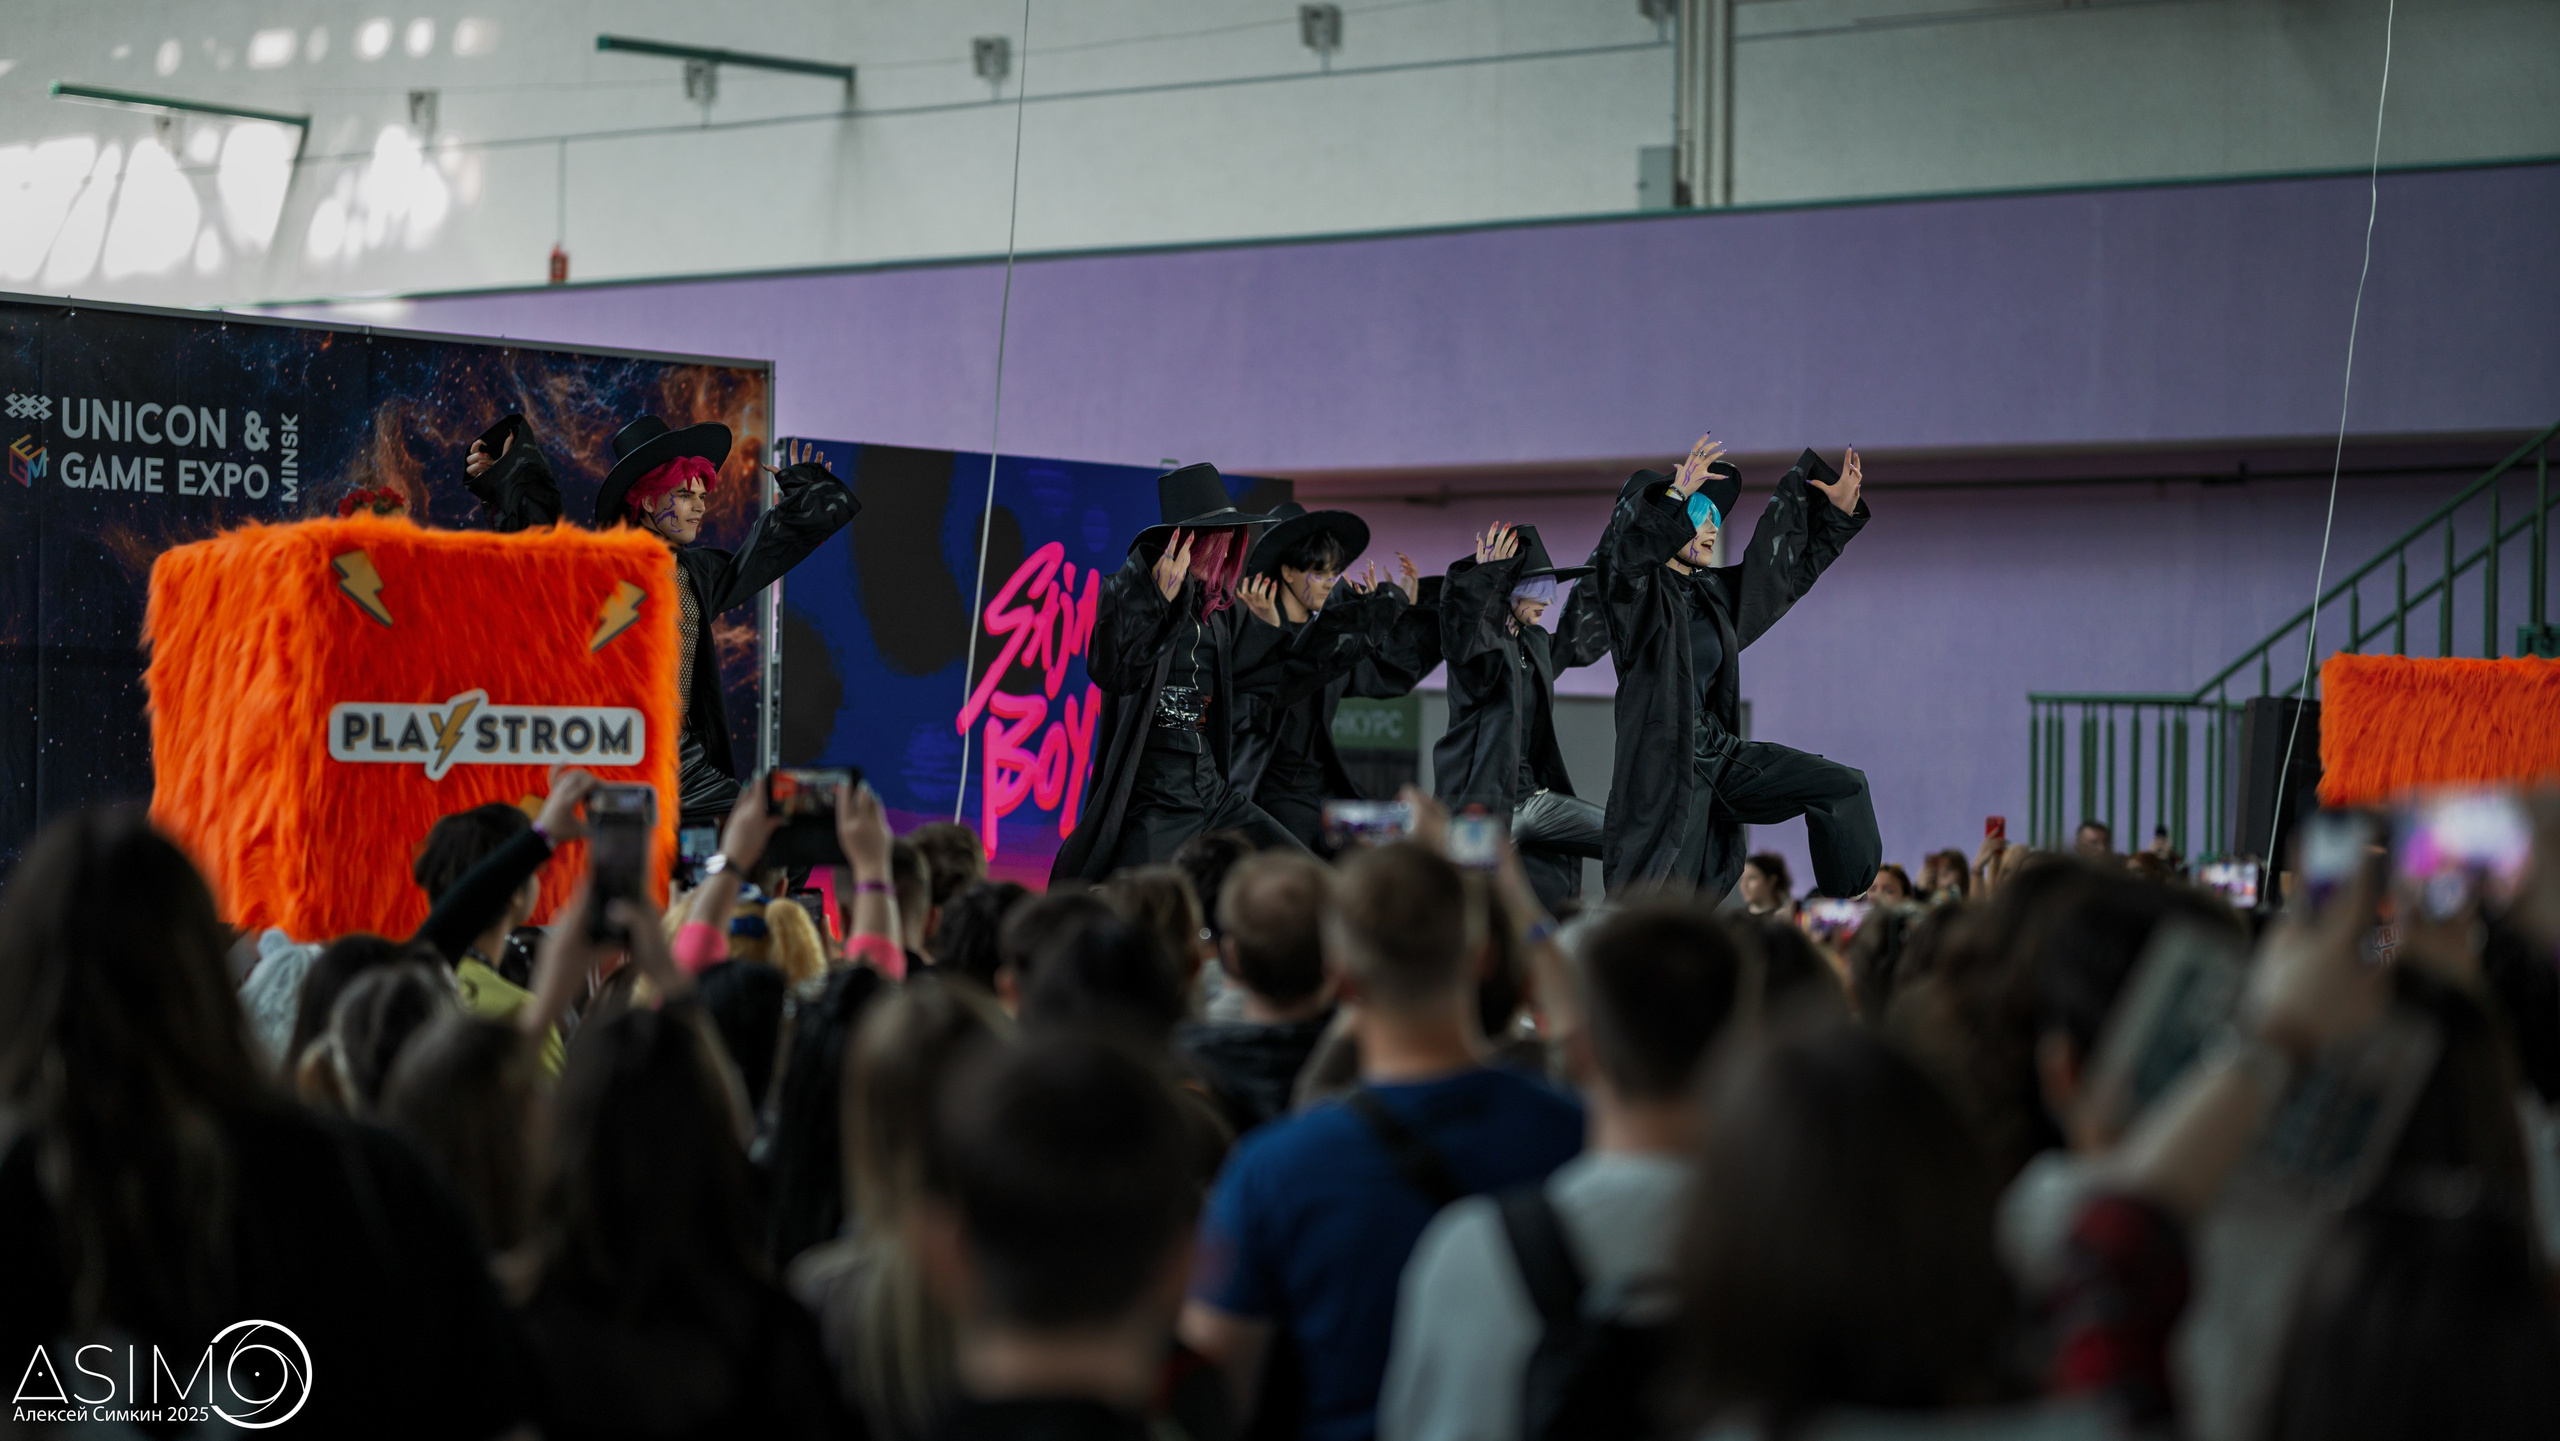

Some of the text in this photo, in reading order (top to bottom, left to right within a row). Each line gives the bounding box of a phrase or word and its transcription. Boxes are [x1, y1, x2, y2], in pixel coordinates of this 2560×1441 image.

[62, 396, 270, 451] UNICON &
[60, 451, 270, 500] GAME EXPO
[281, 412, 299, 502] MINSK
[343, 698, 632, 771] PLAYSTROM
[1331, 709, 1404, 738] НКУРС
[982, 682, 1101, 862] BOY
